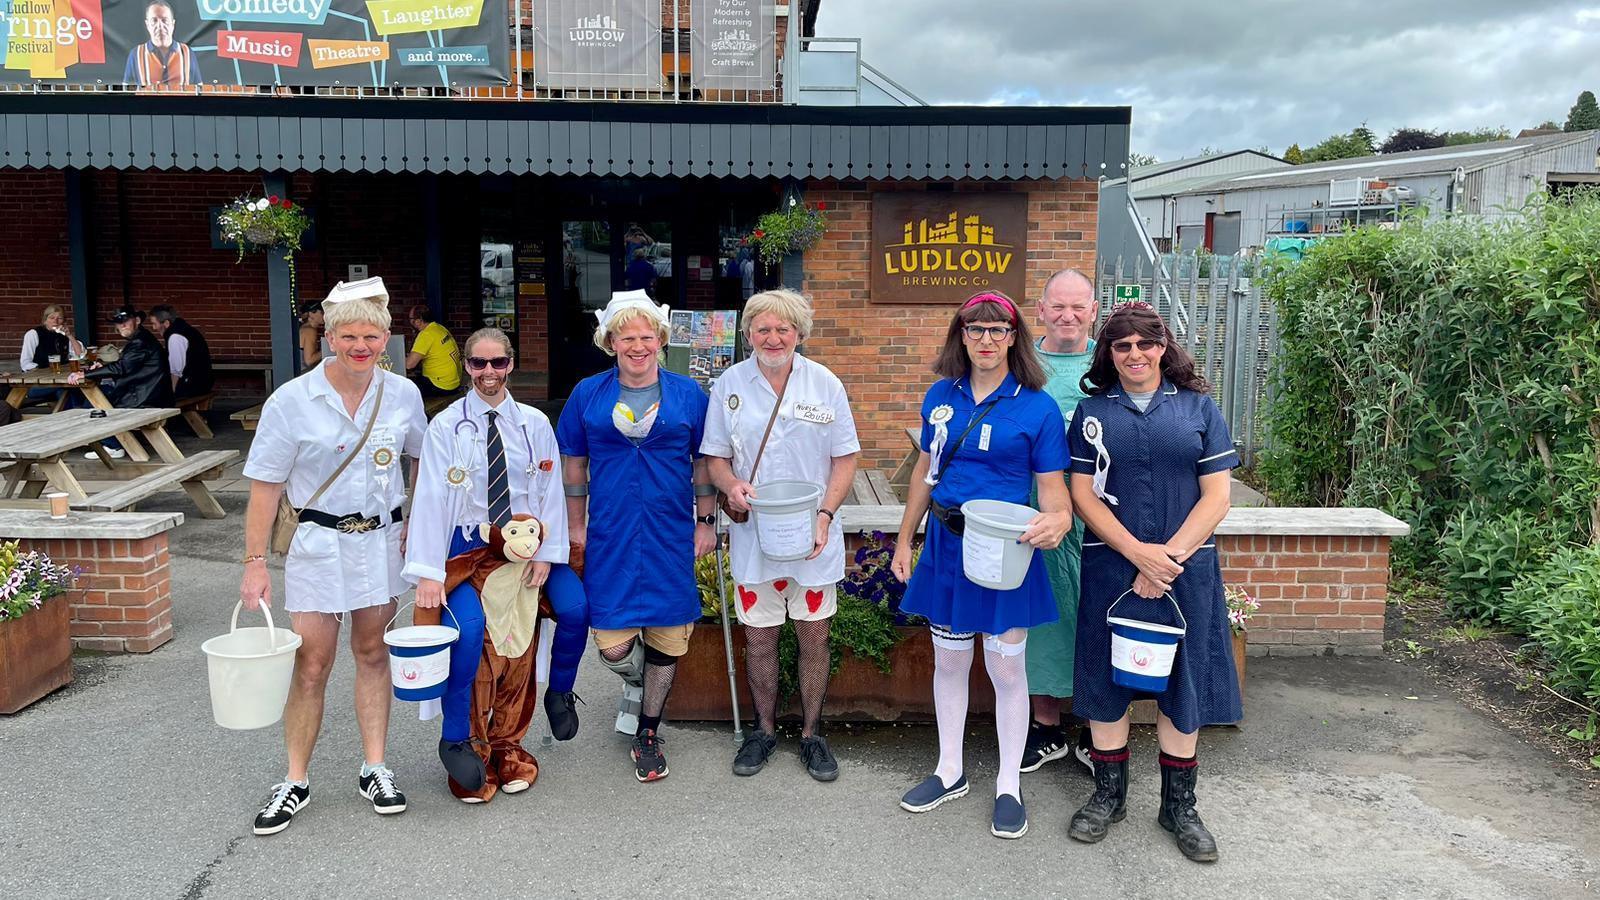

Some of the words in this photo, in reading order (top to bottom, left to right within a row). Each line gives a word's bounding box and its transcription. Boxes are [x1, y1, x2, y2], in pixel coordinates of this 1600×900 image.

[7, 1, 51, 14] Ludlow
[714, 8, 743, 16] Modern
[745, 8, 751, 16] &
[382, 4, 474, 25] Laughter
[712, 18, 752, 27] Refreshing
[569, 30, 625, 42] LUDLOW
[8, 41, 53, 53] Festival
[226, 35, 293, 57] Music
[315, 45, 380, 60] Theatre
[408, 51, 434, 62] and
[437, 52, 485, 62] more...
[711, 58, 730, 66] Craft
[885, 249, 1012, 274] LUDLOW
[903, 276, 968, 286] BREWING
[972, 276, 989, 286] Co
[803, 410, 832, 422] ROUGH
